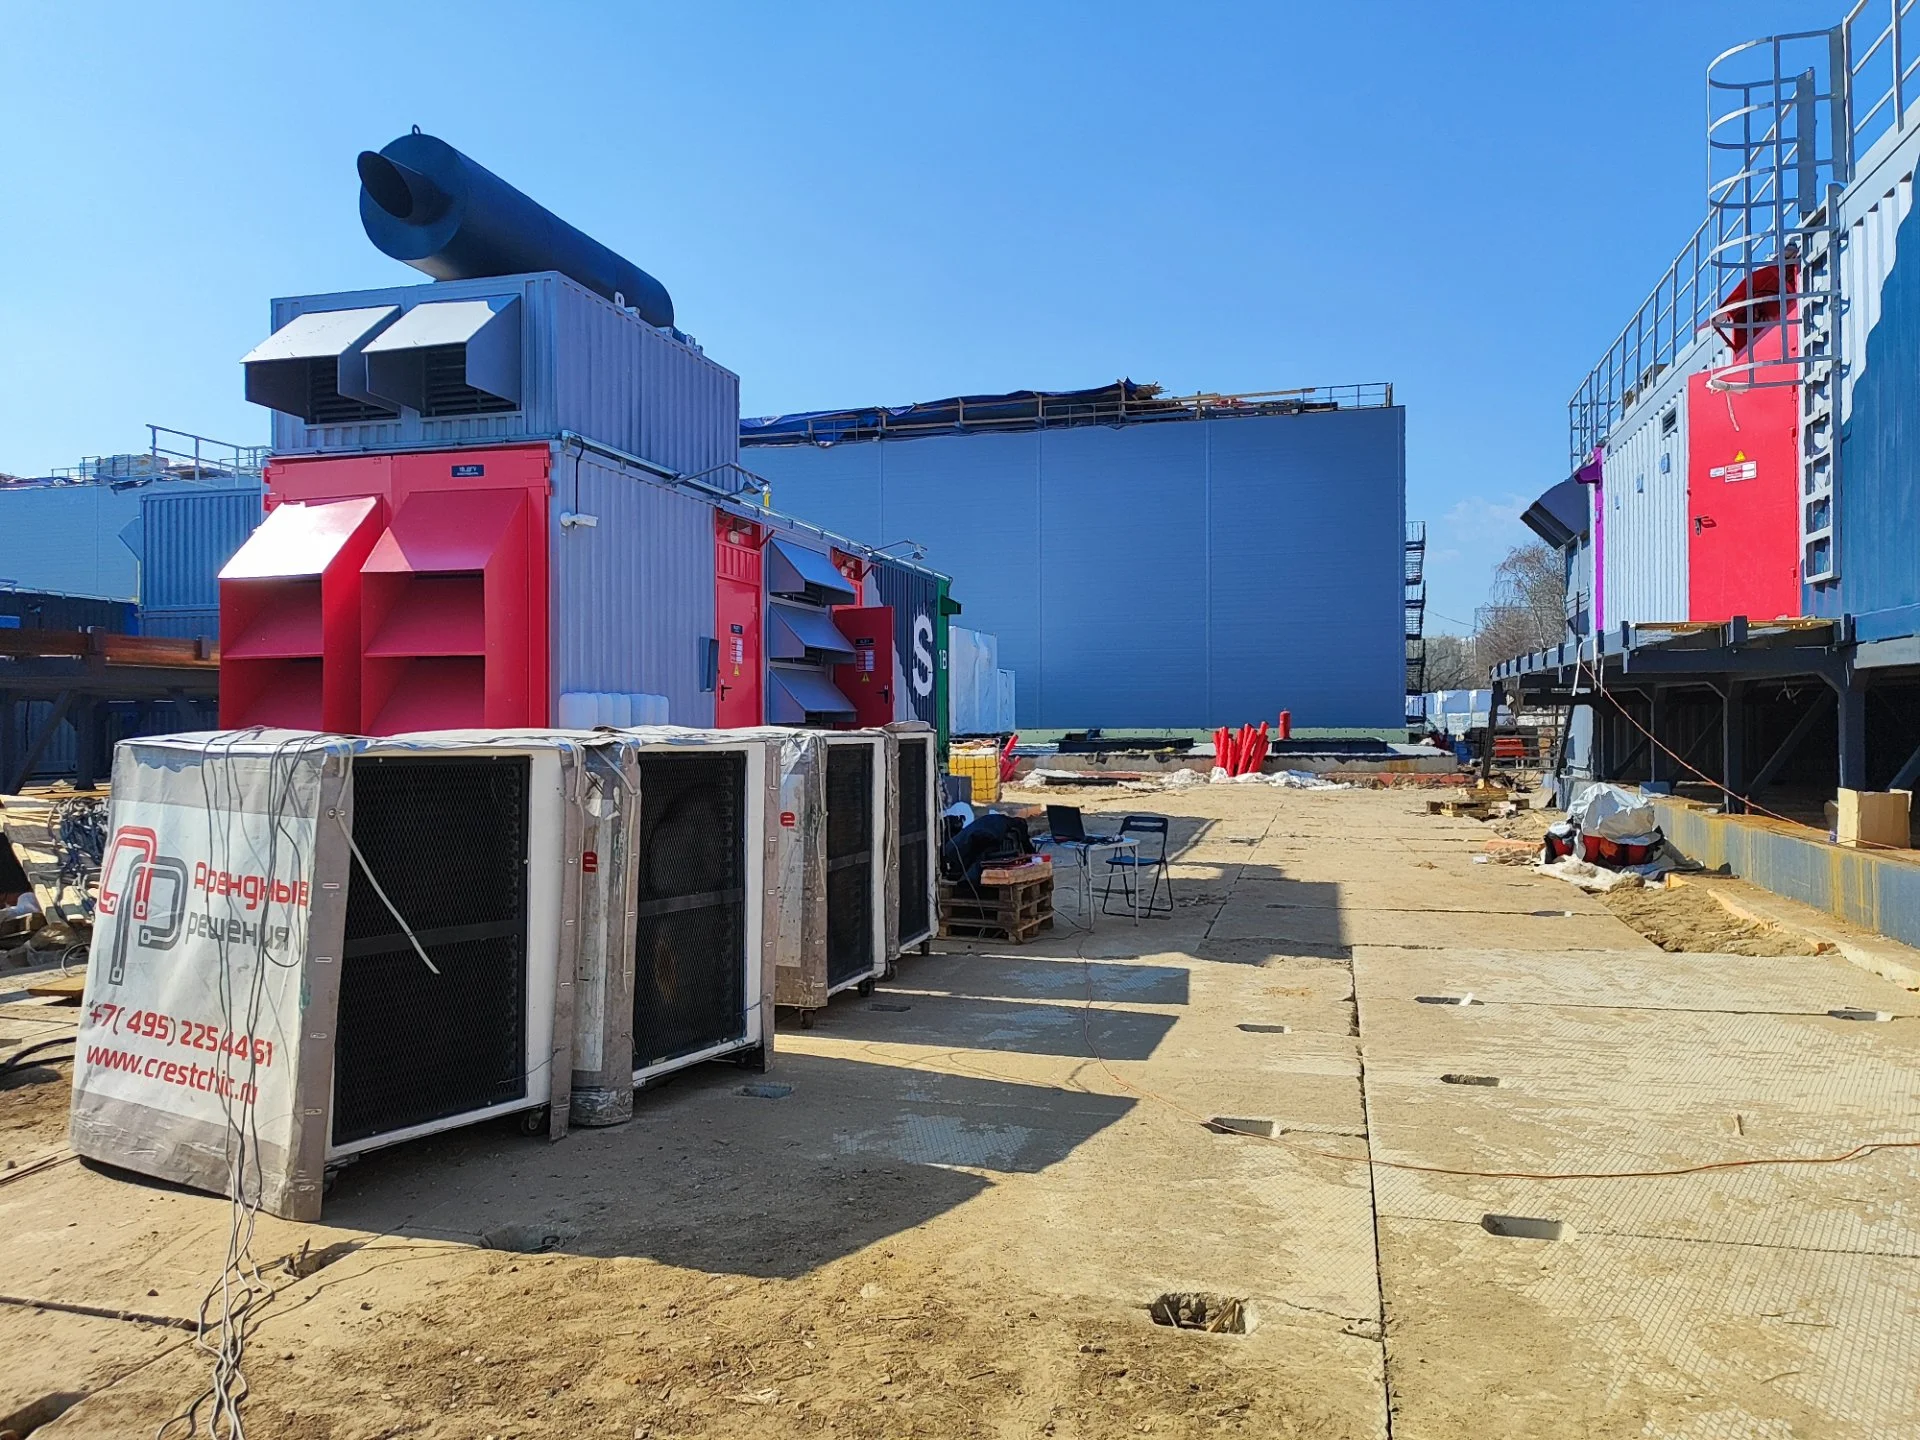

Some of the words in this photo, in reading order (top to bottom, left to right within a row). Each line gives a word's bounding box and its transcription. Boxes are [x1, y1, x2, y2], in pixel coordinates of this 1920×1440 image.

[912, 612, 933, 697] S
[193, 860, 310, 911] Арендные
[185, 911, 290, 951] решения
[86, 1045, 259, 1105] www.crestchic.ru
